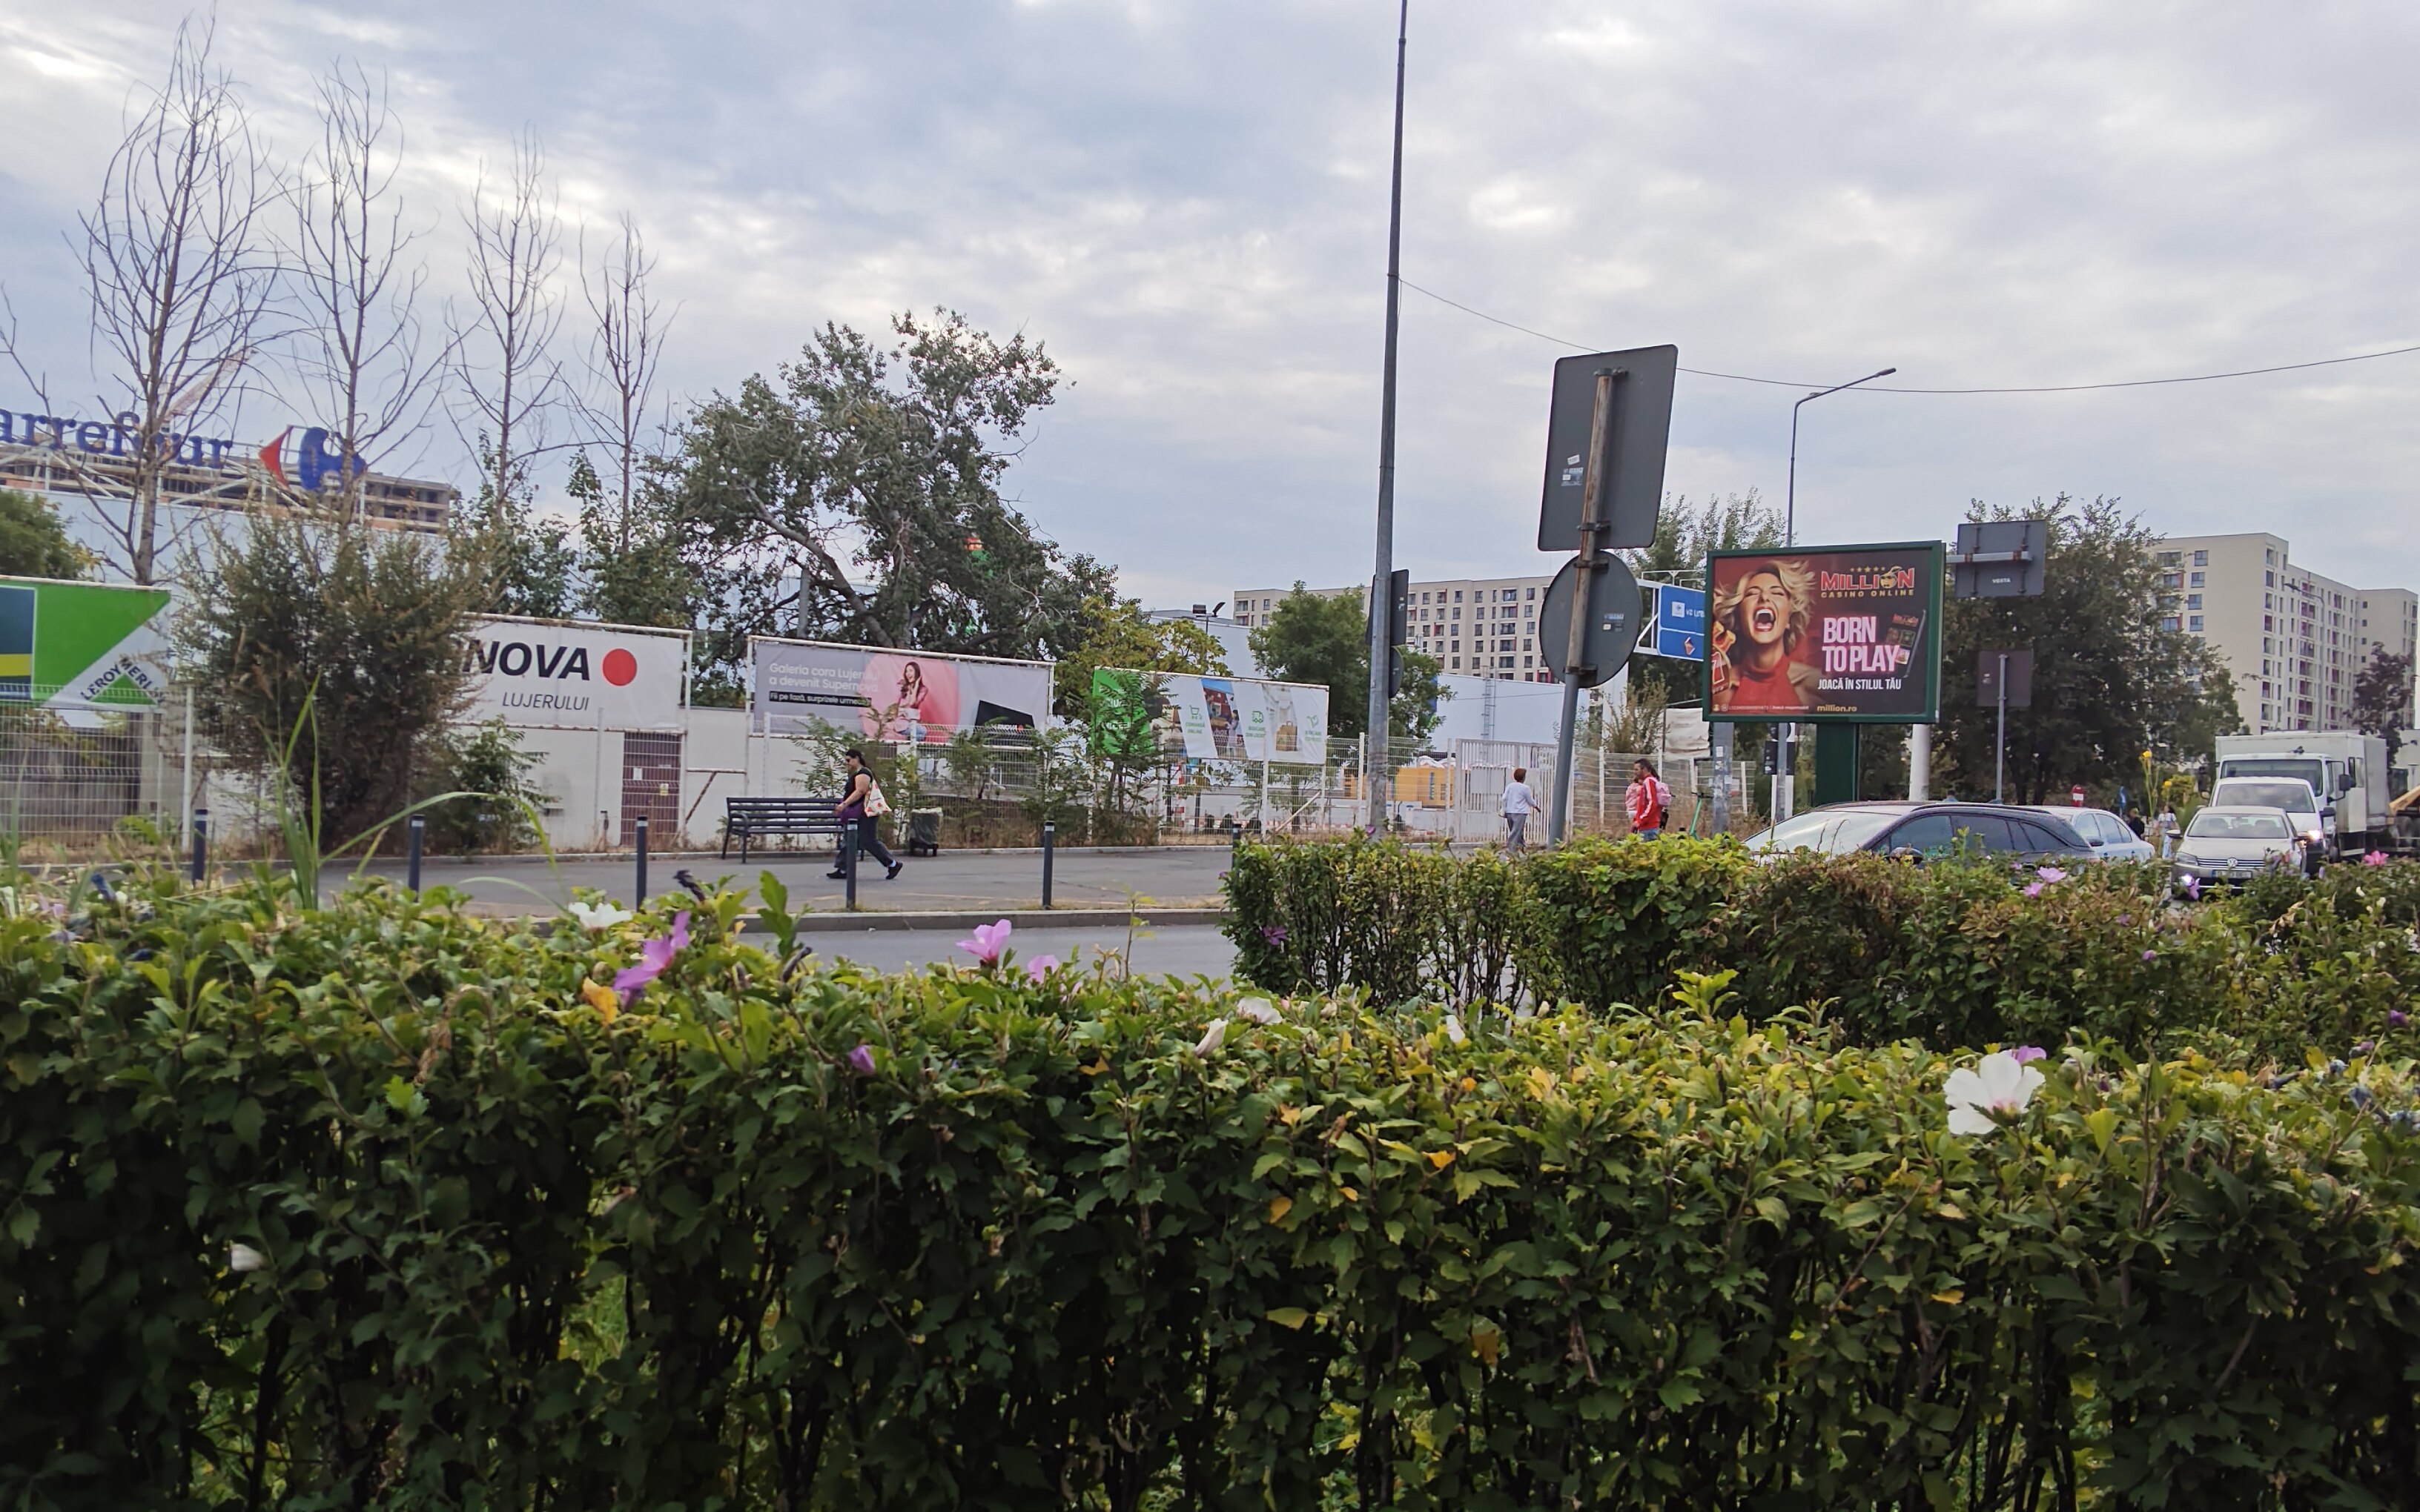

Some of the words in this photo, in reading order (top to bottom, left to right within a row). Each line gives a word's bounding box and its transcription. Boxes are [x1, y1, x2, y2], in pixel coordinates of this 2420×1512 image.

[1824, 617, 1877, 643] BORN
[1822, 646, 1847, 672] TO
[1849, 645, 1900, 672] PLAY
[769, 663, 809, 675] Galeria
[811, 668, 836, 677] cora
[80, 664, 121, 700] LEROY
[119, 657, 165, 703] MERL
[769, 677, 777, 685] a
[779, 676, 820, 688] devenit
[1818, 677, 1843, 689] JOACĂ
[1845, 677, 1854, 689] ÎN
[1855, 680, 1884, 689] STILUL
[1885, 677, 1901, 689] TĂU
[502, 692, 589, 711] LUJERULUI
[807, 695, 839, 704] surprizele
